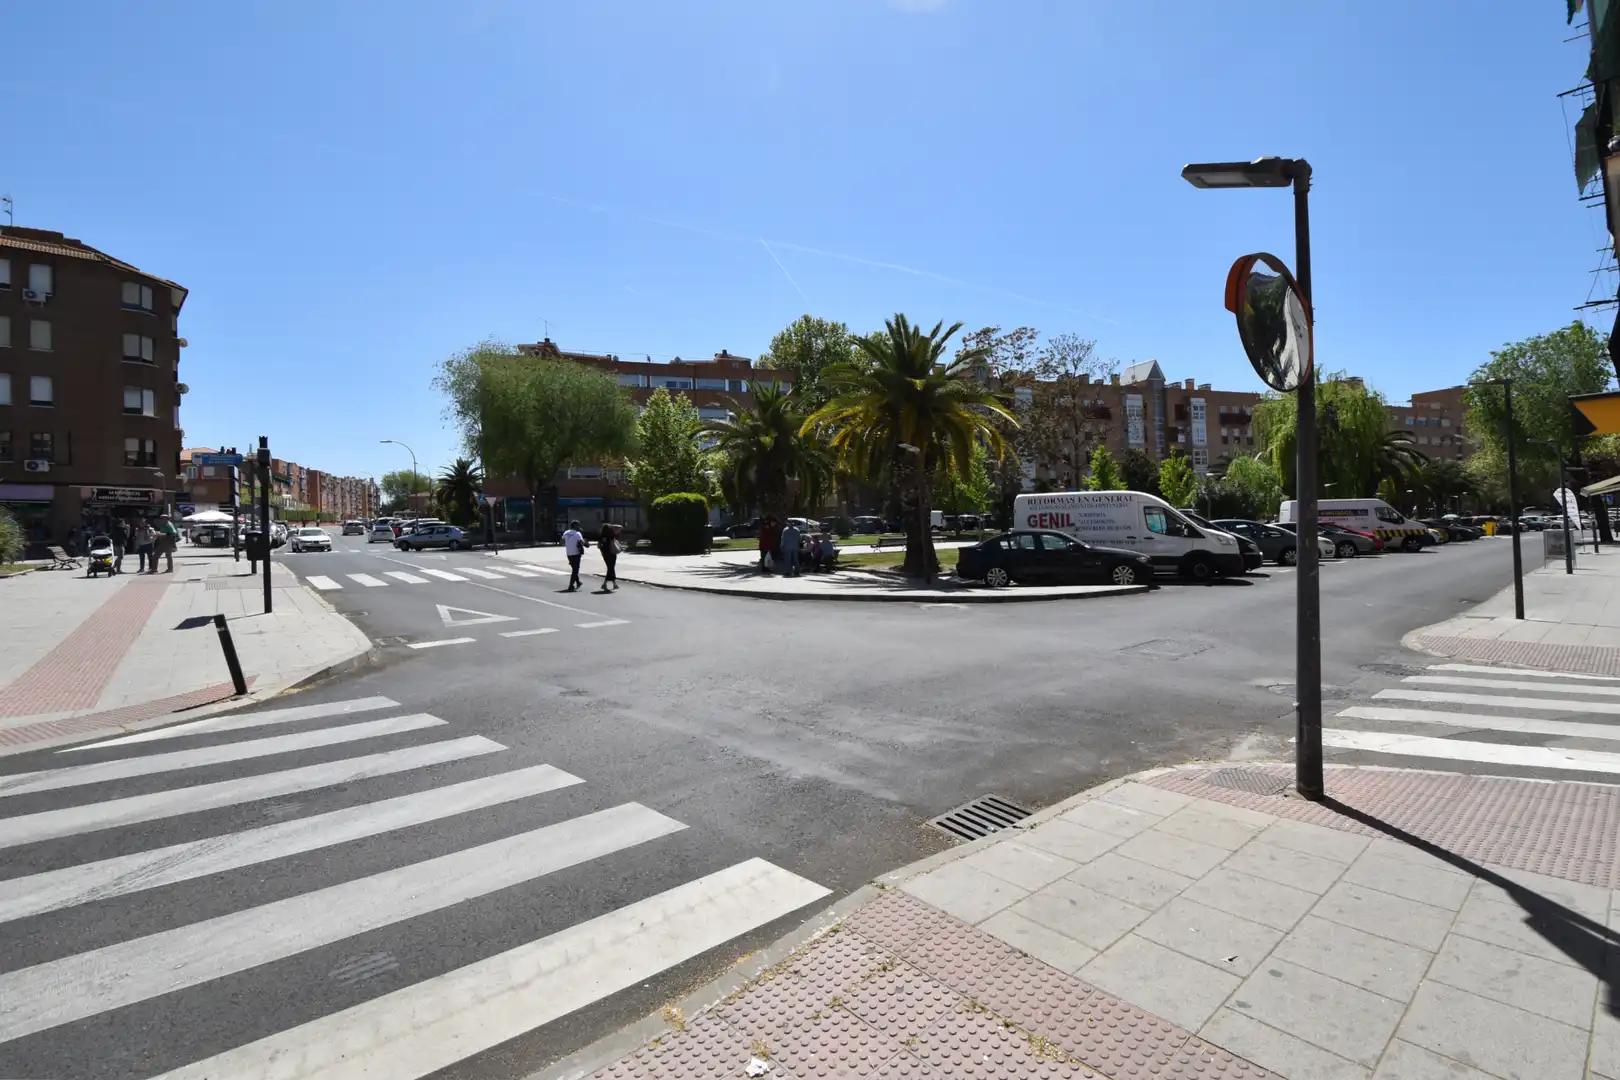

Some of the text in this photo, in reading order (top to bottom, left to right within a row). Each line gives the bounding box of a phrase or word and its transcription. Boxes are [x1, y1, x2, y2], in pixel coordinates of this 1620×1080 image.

[1027, 497, 1075, 505] REFORMAS
[1092, 495, 1132, 503] GENERAL
[1027, 513, 1074, 528] GENIL
